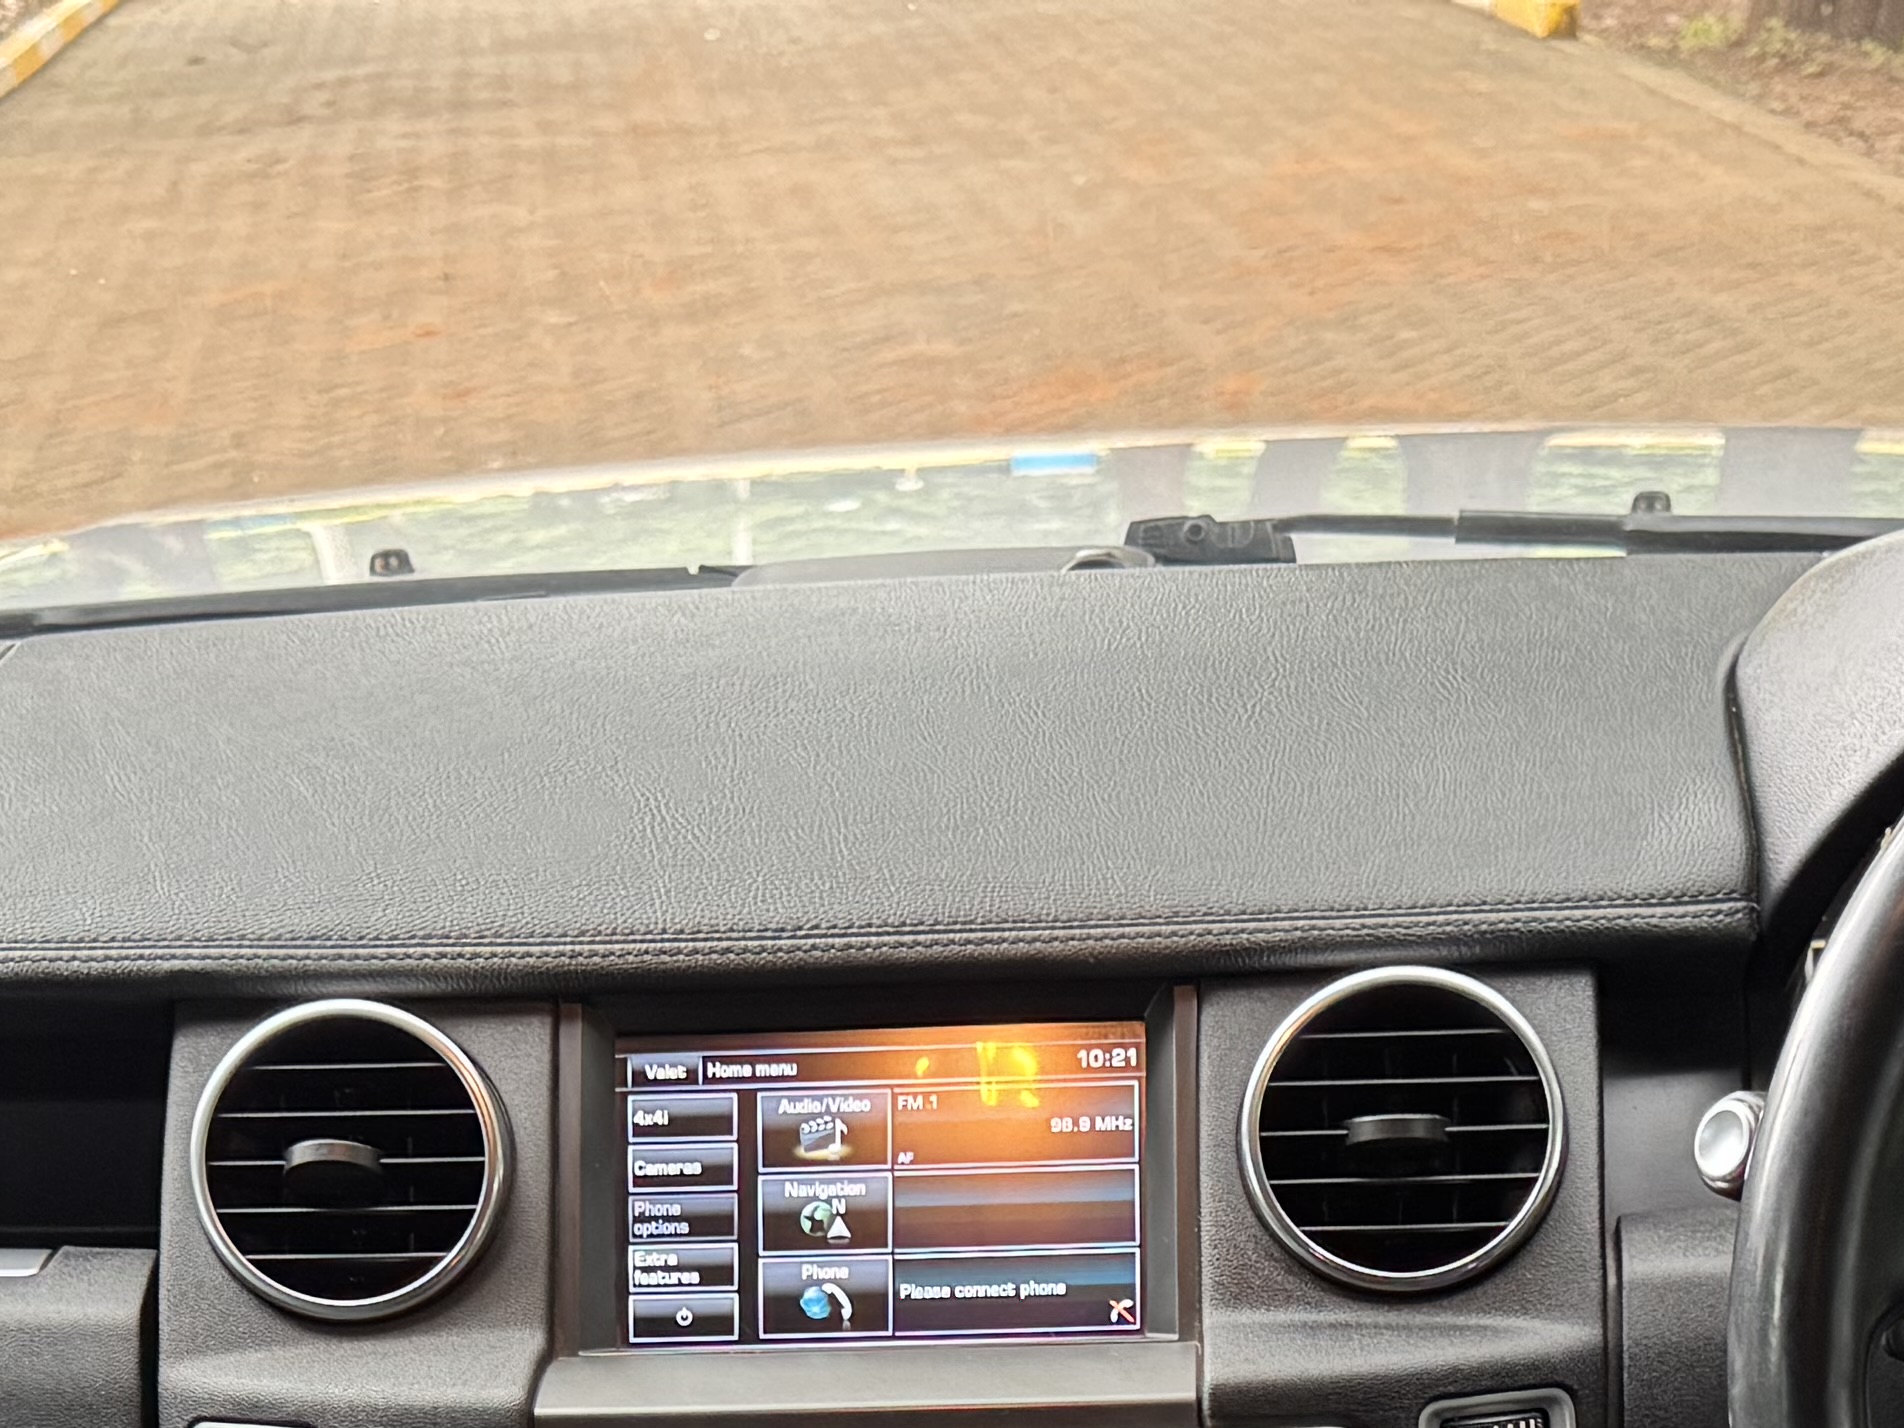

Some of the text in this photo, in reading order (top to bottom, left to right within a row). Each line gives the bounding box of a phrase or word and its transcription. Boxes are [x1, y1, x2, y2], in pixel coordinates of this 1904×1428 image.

[1077, 1047, 1137, 1068] 10:21
[645, 1064, 687, 1081] Valet
[707, 1061, 798, 1078] Home menu
[778, 1096, 871, 1116] Audio/Video
[897, 1095, 924, 1110] FM
[633, 1110, 669, 1127] 4x4i
[1095, 1115, 1133, 1131] MHz
[634, 1158, 702, 1176] Cameras
[897, 1152, 914, 1165] AF
[784, 1180, 866, 1200] Navigation
[634, 1200, 681, 1217] Phone
[634, 1219, 689, 1237] options
[634, 1251, 678, 1268] Extra
[633, 1269, 700, 1286] features
[801, 1263, 849, 1280] Phone
[899, 1281, 1067, 1299] Please connect phone
